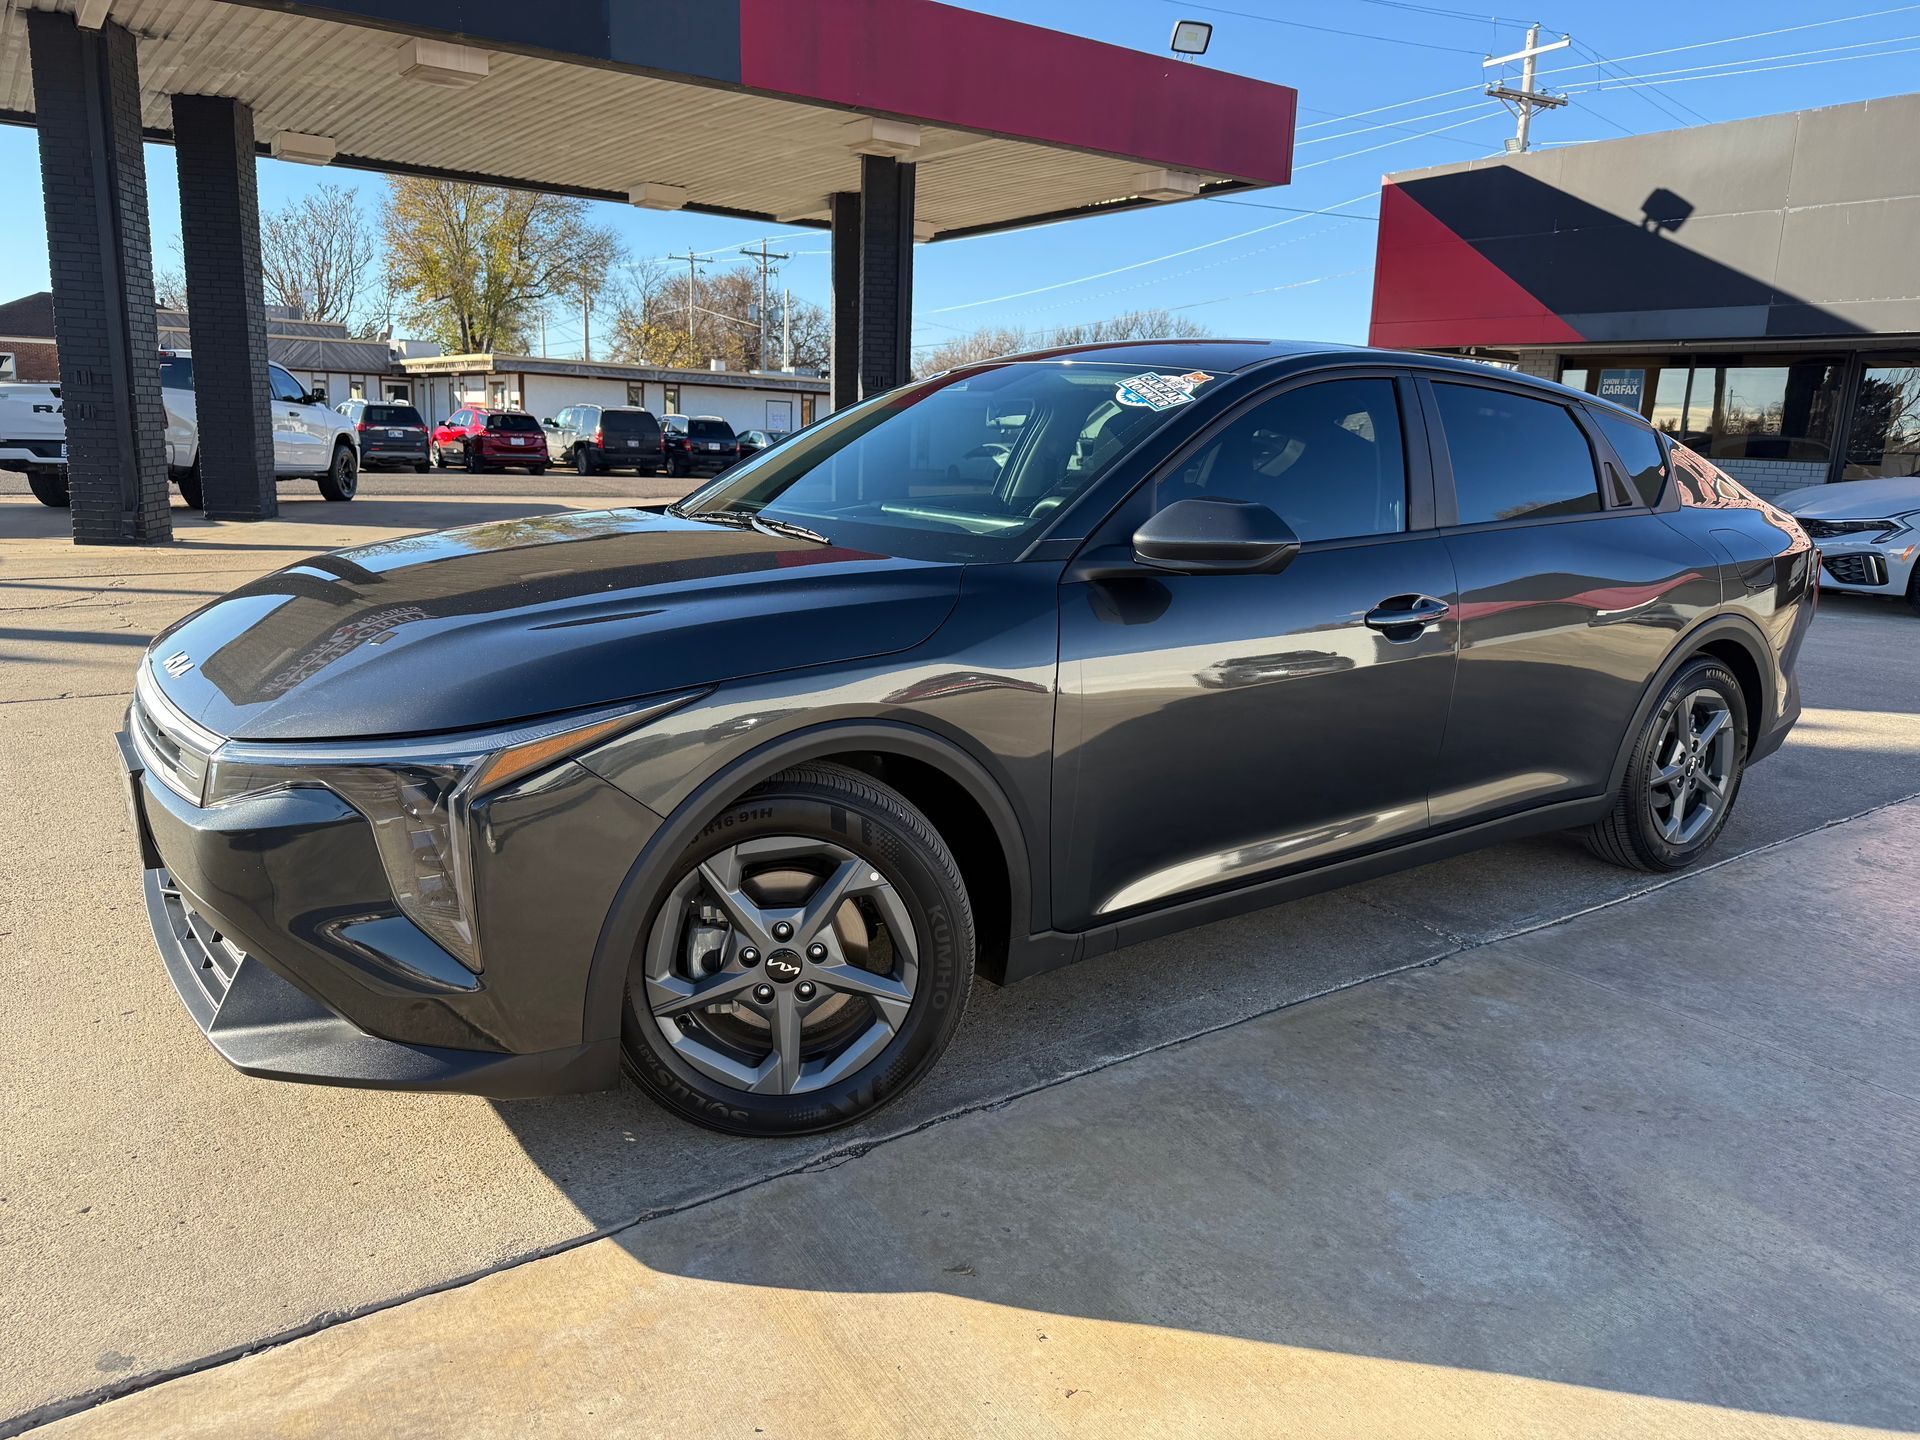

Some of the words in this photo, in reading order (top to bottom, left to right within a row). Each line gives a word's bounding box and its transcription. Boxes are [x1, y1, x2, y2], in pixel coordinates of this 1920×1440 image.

[1140, 375, 1184, 403] CARFAX
[1602, 384, 1639, 395] CARFAX
[1705, 669, 1736, 689] KUMHO
[739, 807, 774, 822] 91H
[928, 904, 953, 1010] KUMHO
